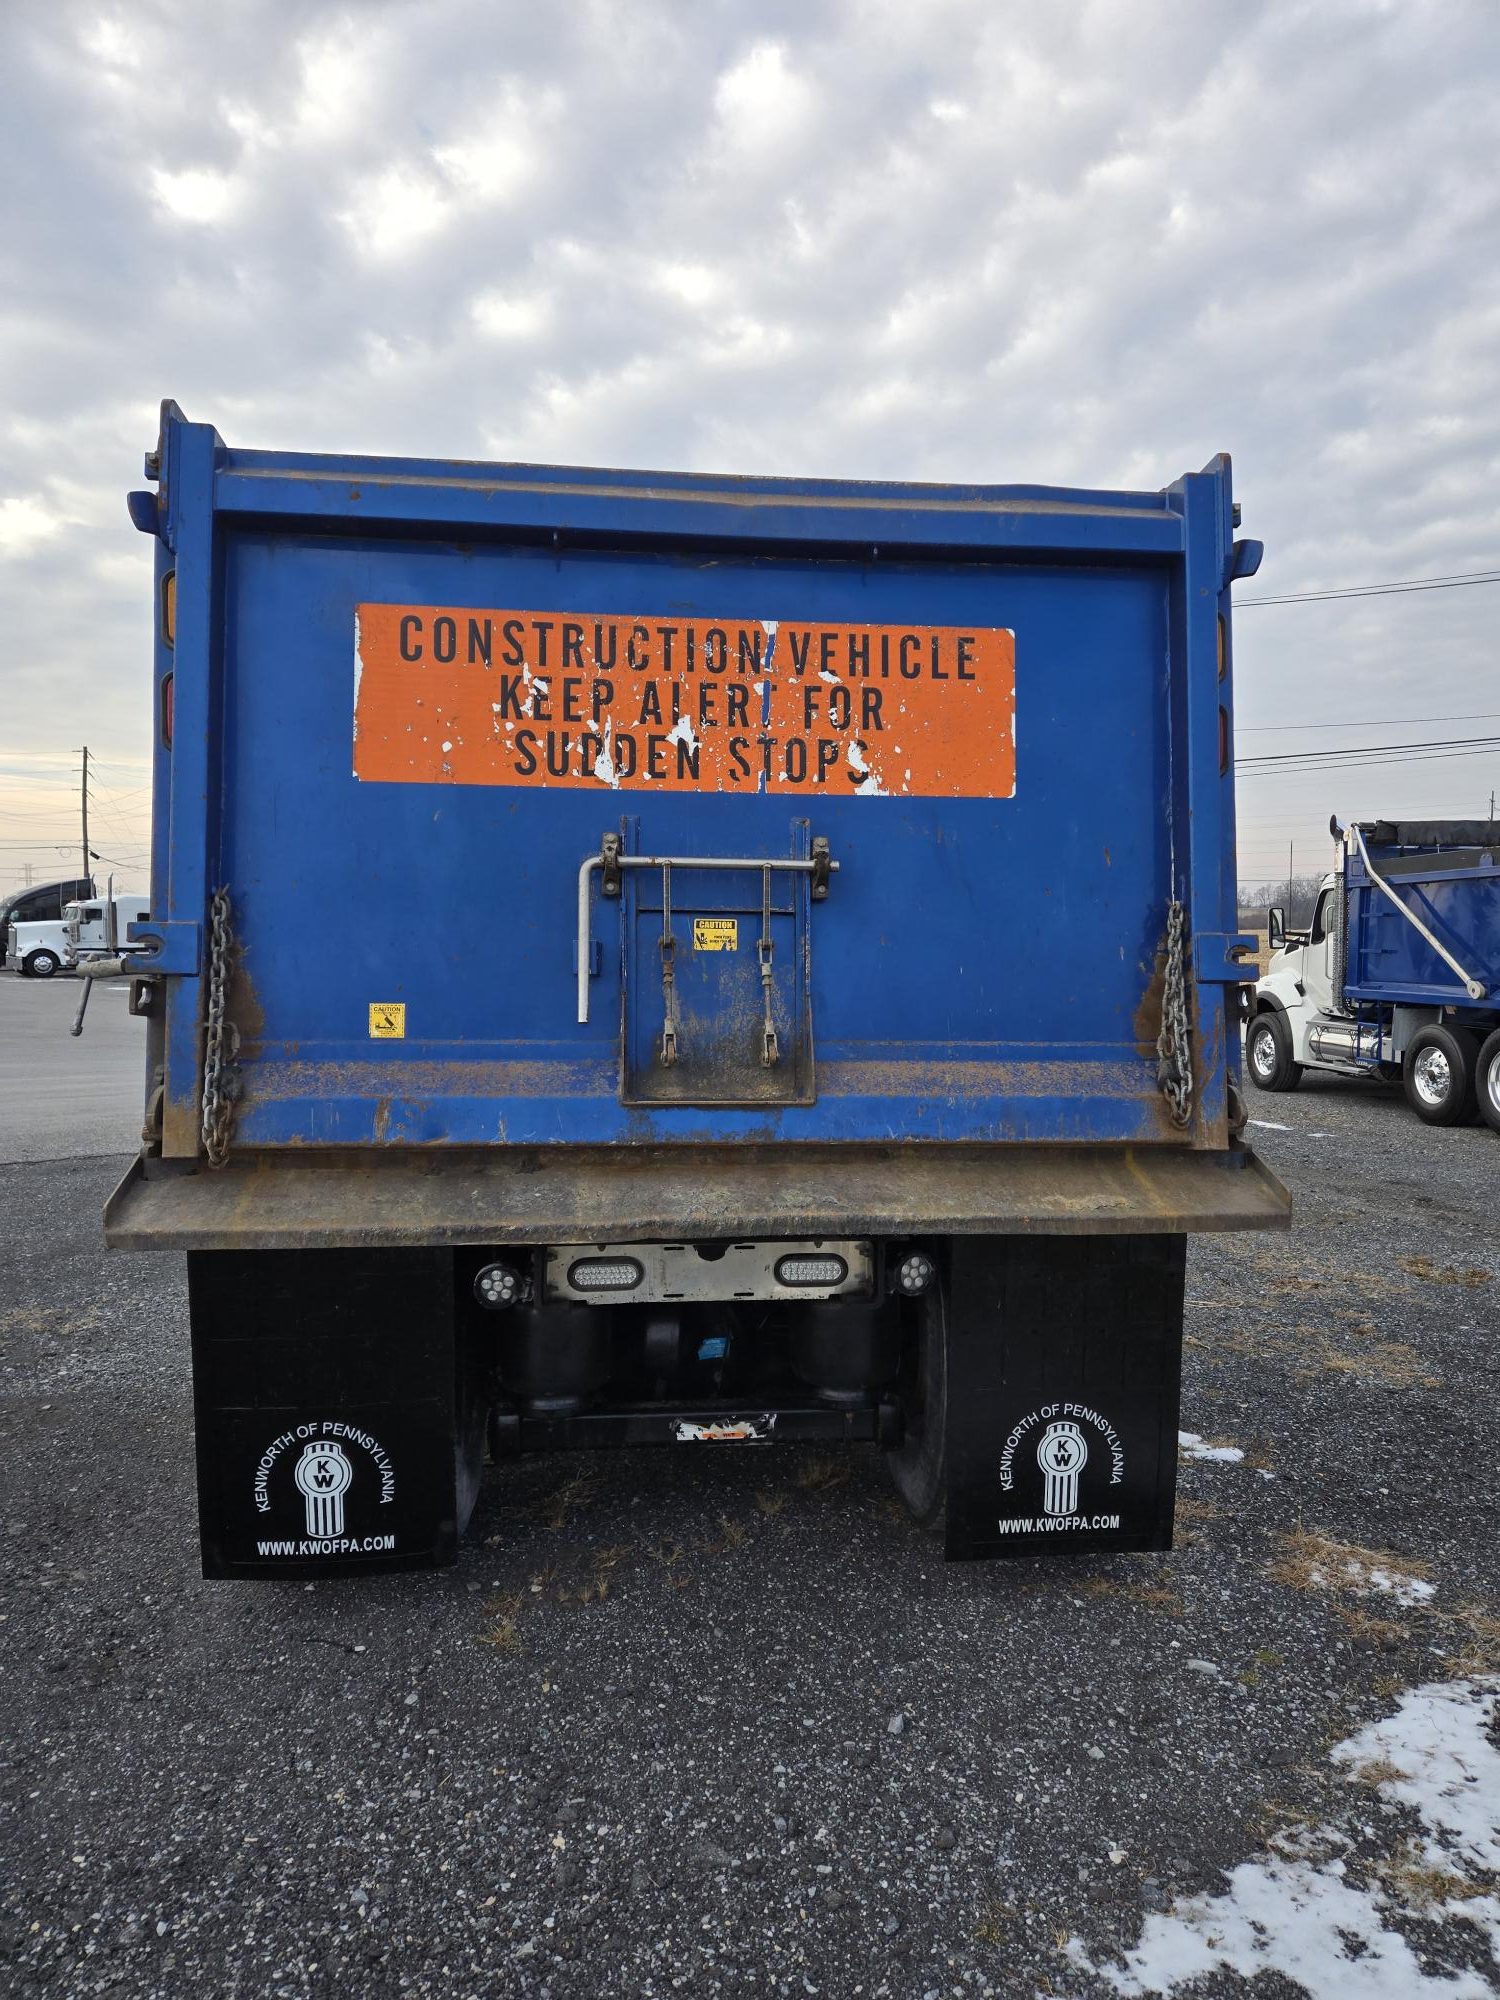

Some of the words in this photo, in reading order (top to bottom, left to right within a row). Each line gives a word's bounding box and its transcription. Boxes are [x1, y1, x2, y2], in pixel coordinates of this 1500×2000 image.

[400, 615, 760, 674] CONSTRUCTION
[789, 632, 976, 680] VEHICLE
[500, 674, 614, 722] KEEP
[640, 681, 777, 728] ALER
[804, 685, 883, 731] FOR
[514, 729, 700, 780] SUDDEN
[700, 920, 732, 928] CAUTION
[254, 1432, 296, 1513] KENWORTH
[296, 1422, 318, 1438] OF
[322, 1422, 395, 1504] PENNSYLVANIA
[999, 1412, 1039, 1491] KENWORTH
[1041, 1404, 1060, 1419] OF
[1064, 1403, 1124, 1484] PENNSYLVANIA
[257, 1535, 395, 1556] WWW.KWOFPA.COM
[999, 1515, 1120, 1534] WWW.KWOFPA.COM
